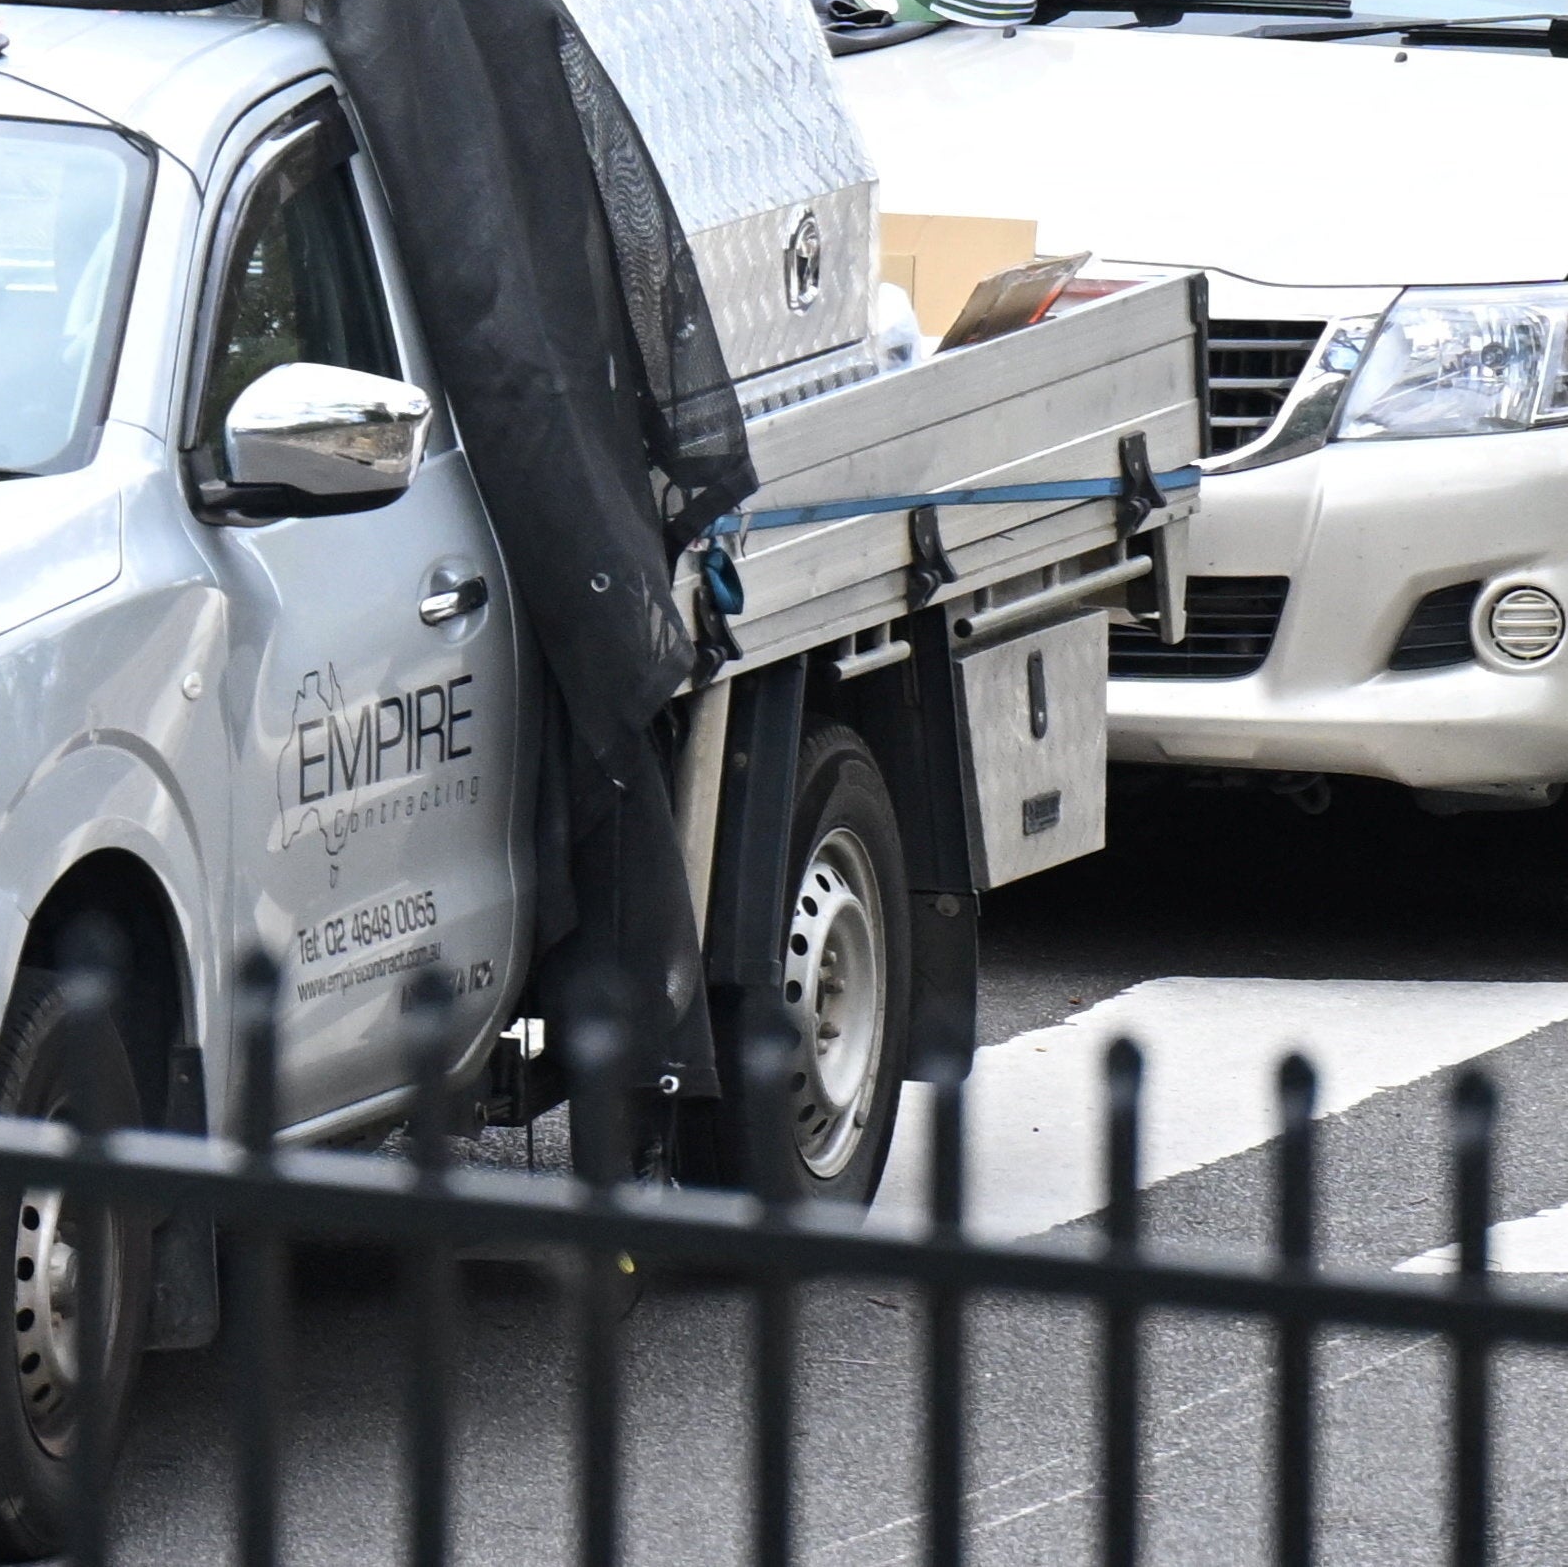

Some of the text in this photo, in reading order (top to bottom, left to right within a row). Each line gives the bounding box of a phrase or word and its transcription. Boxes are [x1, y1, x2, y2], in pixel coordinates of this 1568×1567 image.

[298, 674, 472, 805] EMPIRE
[334, 776, 480, 838] Contracting
[297, 890, 437, 965] Tel: 02 4648 0055
